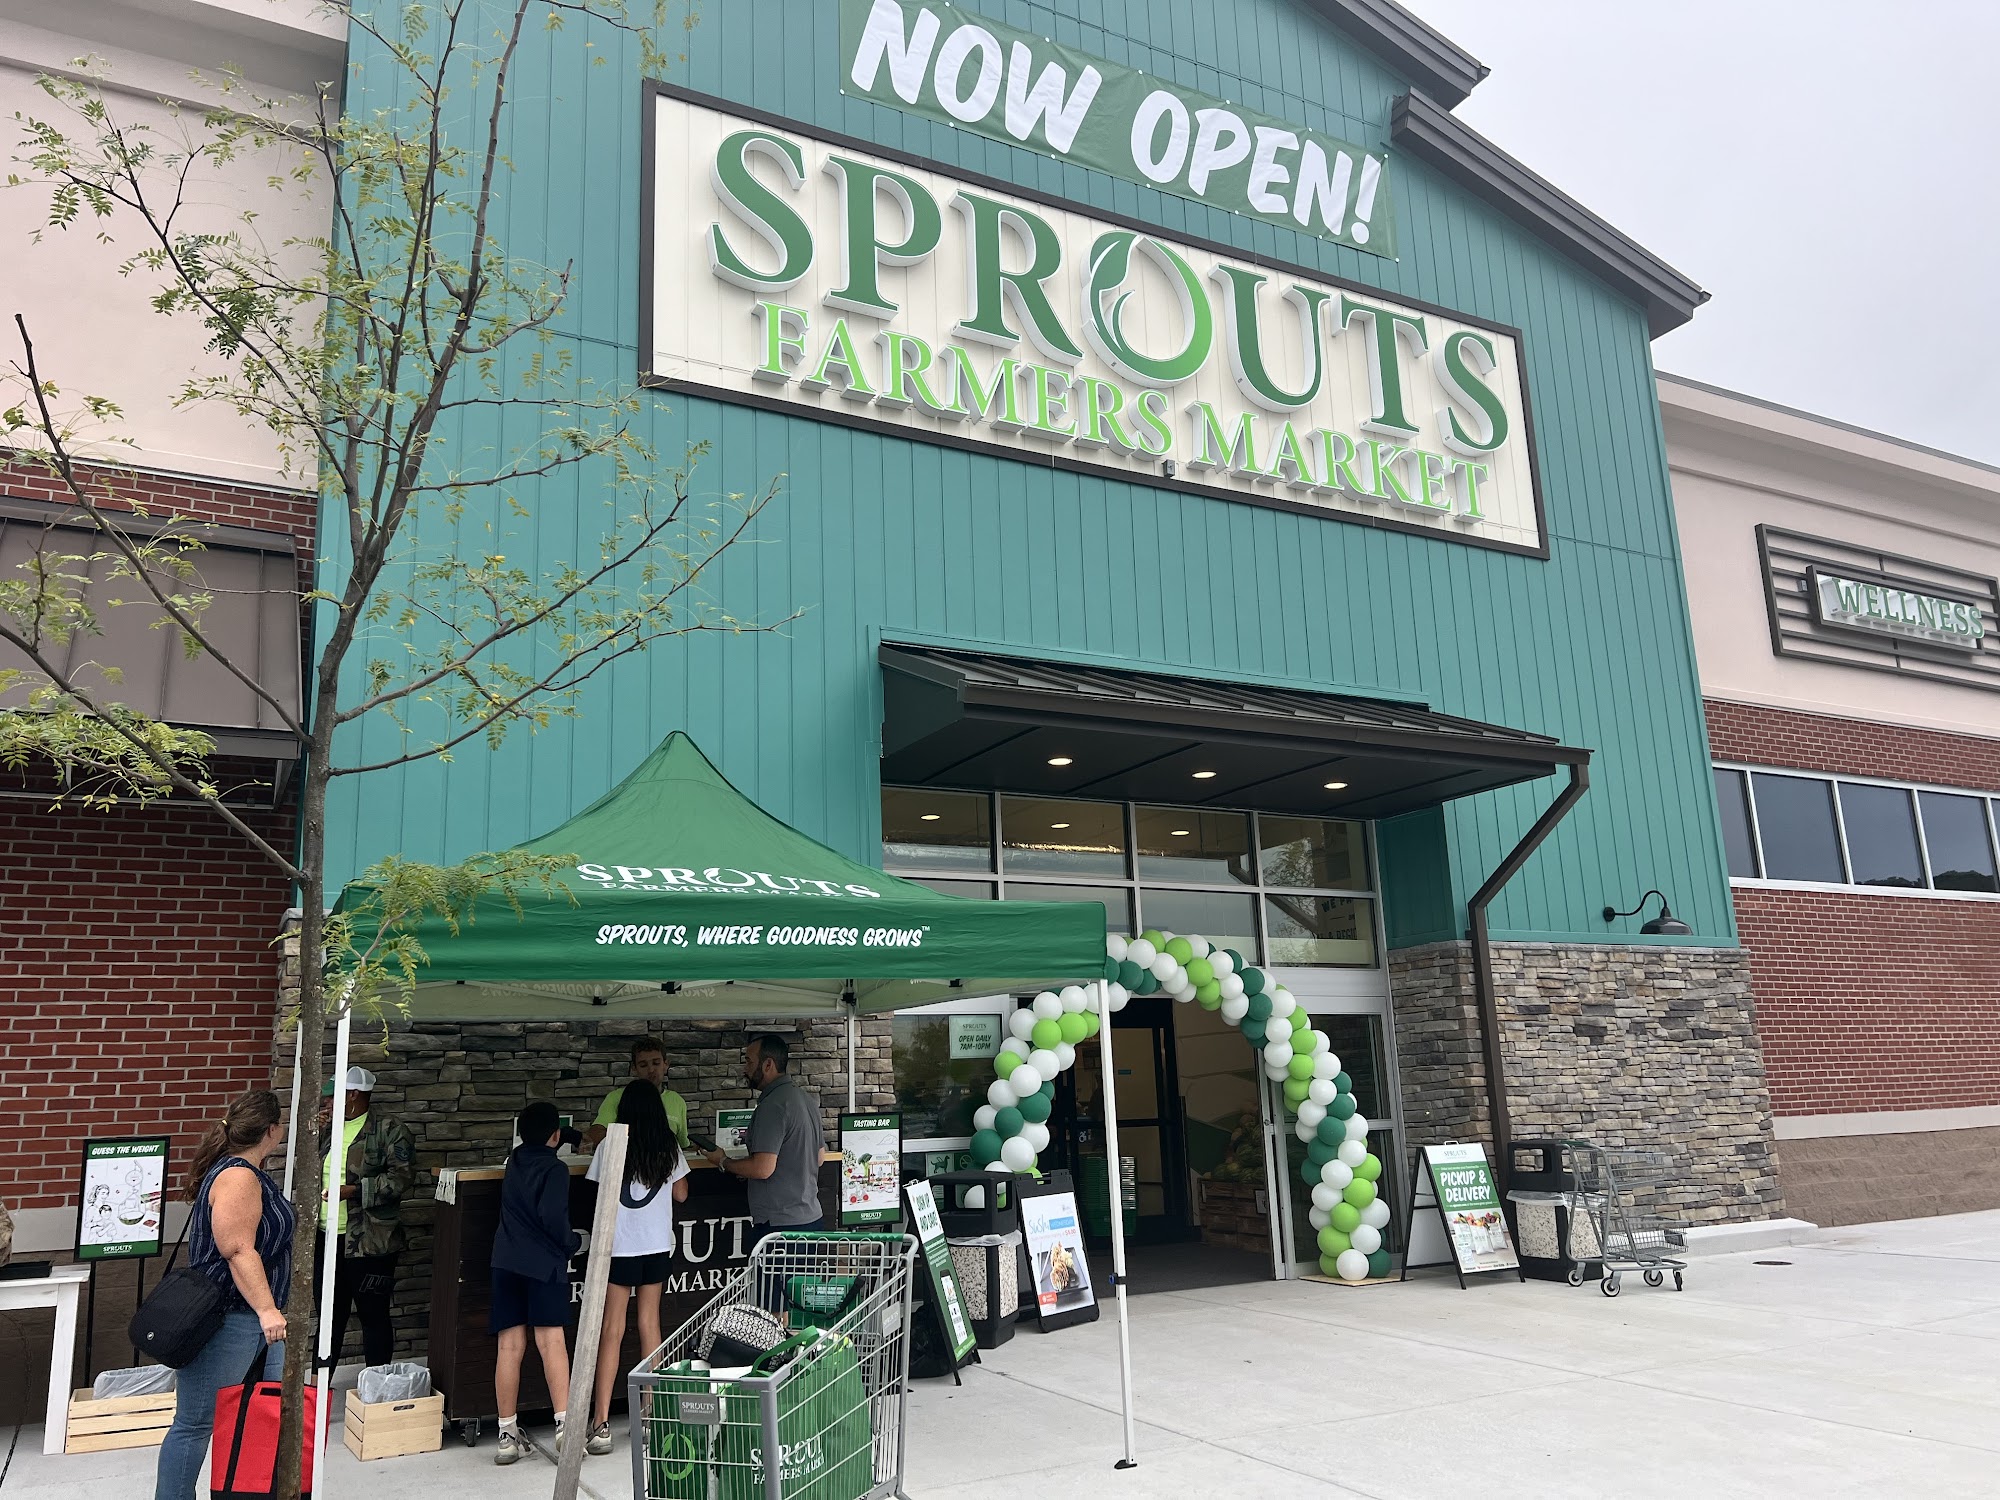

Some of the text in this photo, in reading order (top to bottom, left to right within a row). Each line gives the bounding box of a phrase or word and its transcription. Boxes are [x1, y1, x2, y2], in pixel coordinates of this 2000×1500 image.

[851, 0, 1382, 245] NOW OPEN!
[709, 129, 1509, 457] SPROUTS
[756, 300, 1489, 524] FARMERS MARKET
[1829, 577, 1985, 639] WELLNESS
[576, 863, 882, 899] SPROUTS
[595, 924, 690, 949] SPROUTS,
[697, 925, 764, 946] WHERE
[766, 925, 859, 947] GOODNESS
[958, 1034, 992, 1043] OPEN DAILY
[959, 1042, 991, 1050] 7AM-10PM
[853, 1118, 891, 1128] TASTING BAR
[92, 1145, 160, 1156] GUESS THE WEIGHT
[1440, 1169, 1487, 1187] PICKUP &
[1445, 1185, 1491, 1203] DELIVERY
[103, 1244, 133, 1252] SPROUTS
[681, 1401, 715, 1411] SPROUTS
